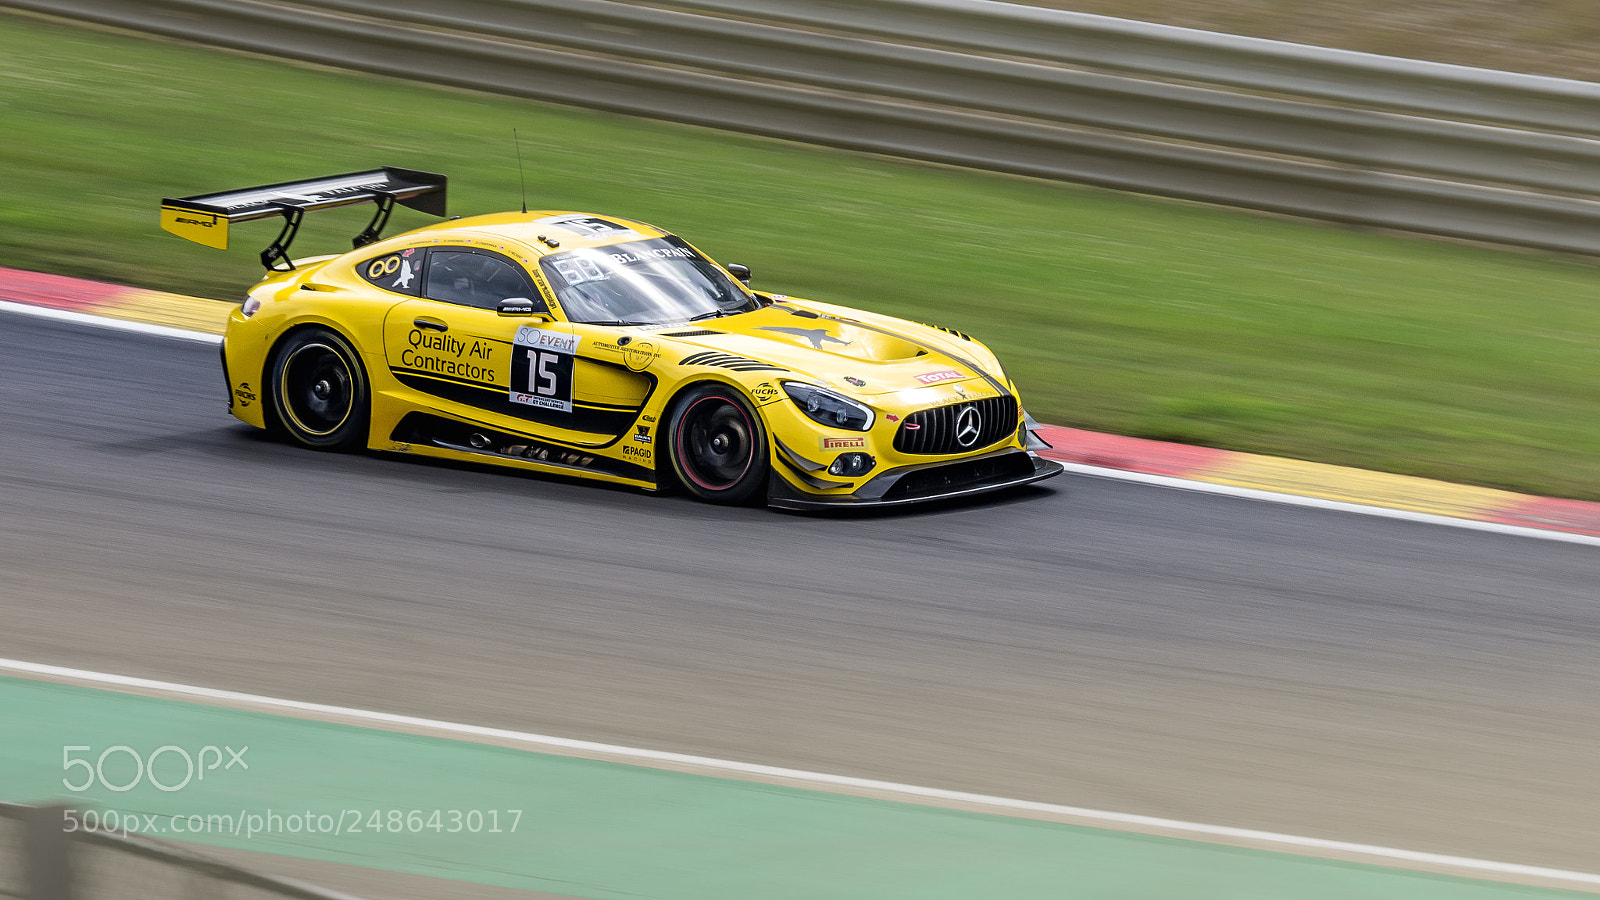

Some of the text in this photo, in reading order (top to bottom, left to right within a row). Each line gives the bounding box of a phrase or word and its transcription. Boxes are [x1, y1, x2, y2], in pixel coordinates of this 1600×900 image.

[610, 247, 697, 264] BLANCPAIN
[408, 329, 493, 360] Quality Air
[401, 349, 495, 382] Contractors
[526, 350, 559, 396] 15
[916, 371, 964, 383] TOTAL
[235, 389, 257, 401] FUCHS
[631, 446, 652, 459] PAGID
